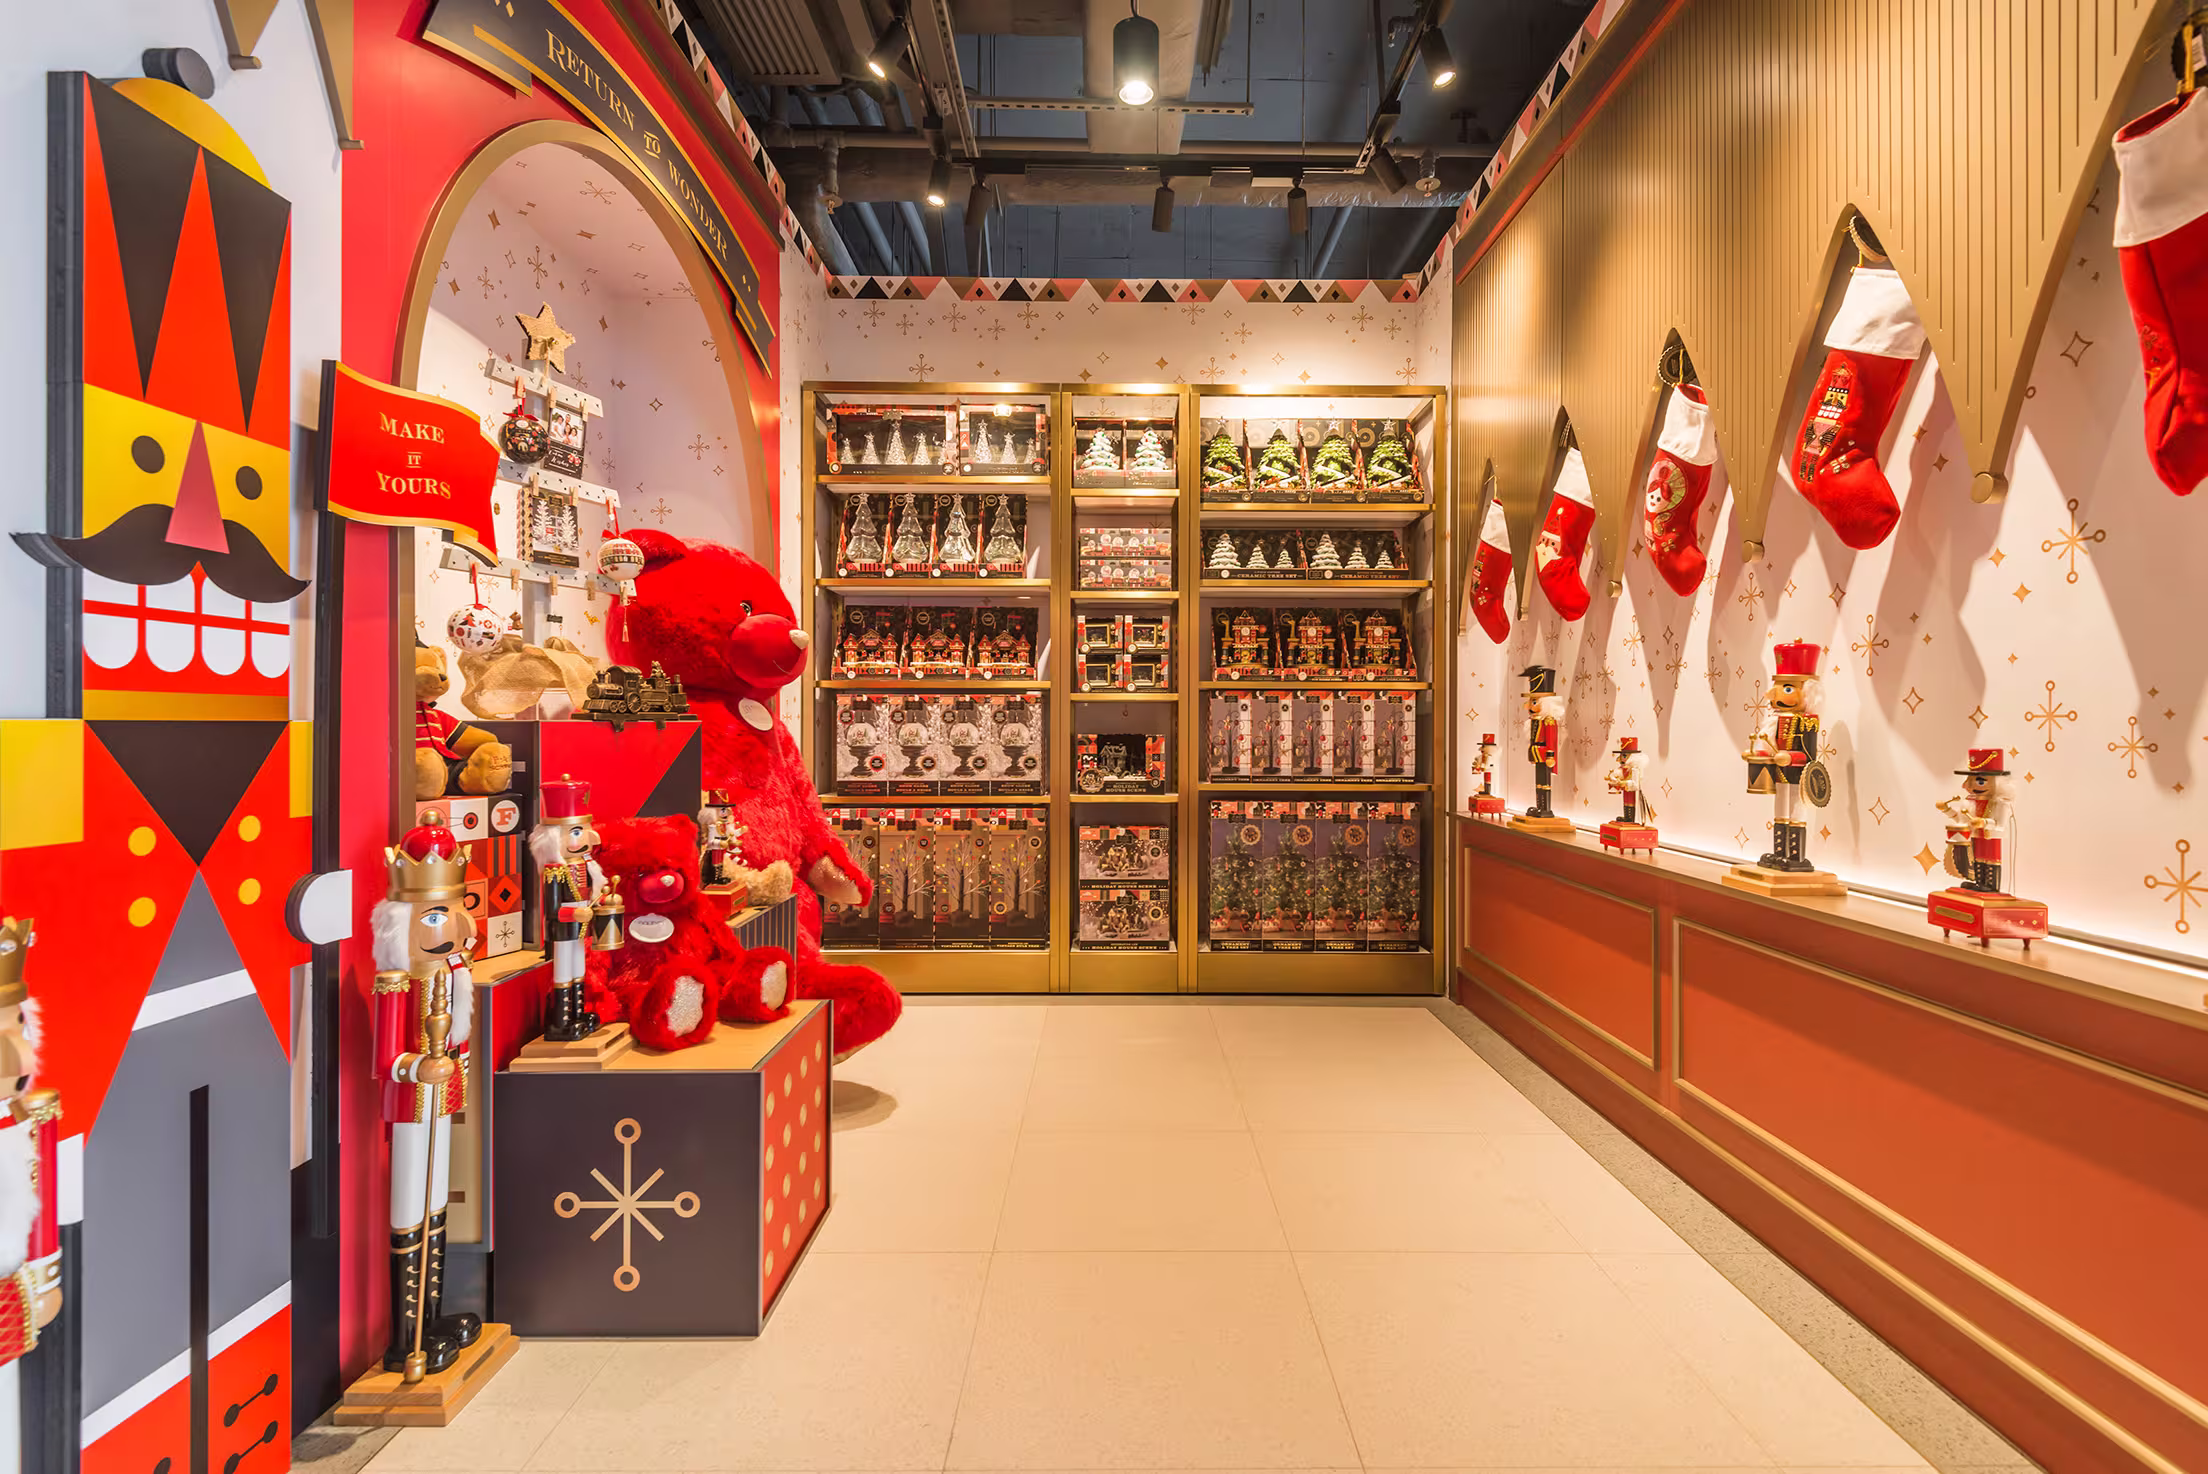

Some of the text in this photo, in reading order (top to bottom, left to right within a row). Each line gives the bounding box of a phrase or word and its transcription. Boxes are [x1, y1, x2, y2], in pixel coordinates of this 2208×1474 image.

[545, 28, 728, 261] RETURN TO WONDER
[379, 412, 445, 445] MAKE
[407, 453, 422, 466] IT
[376, 470, 451, 500] YOURS
[496, 807, 517, 826] F
